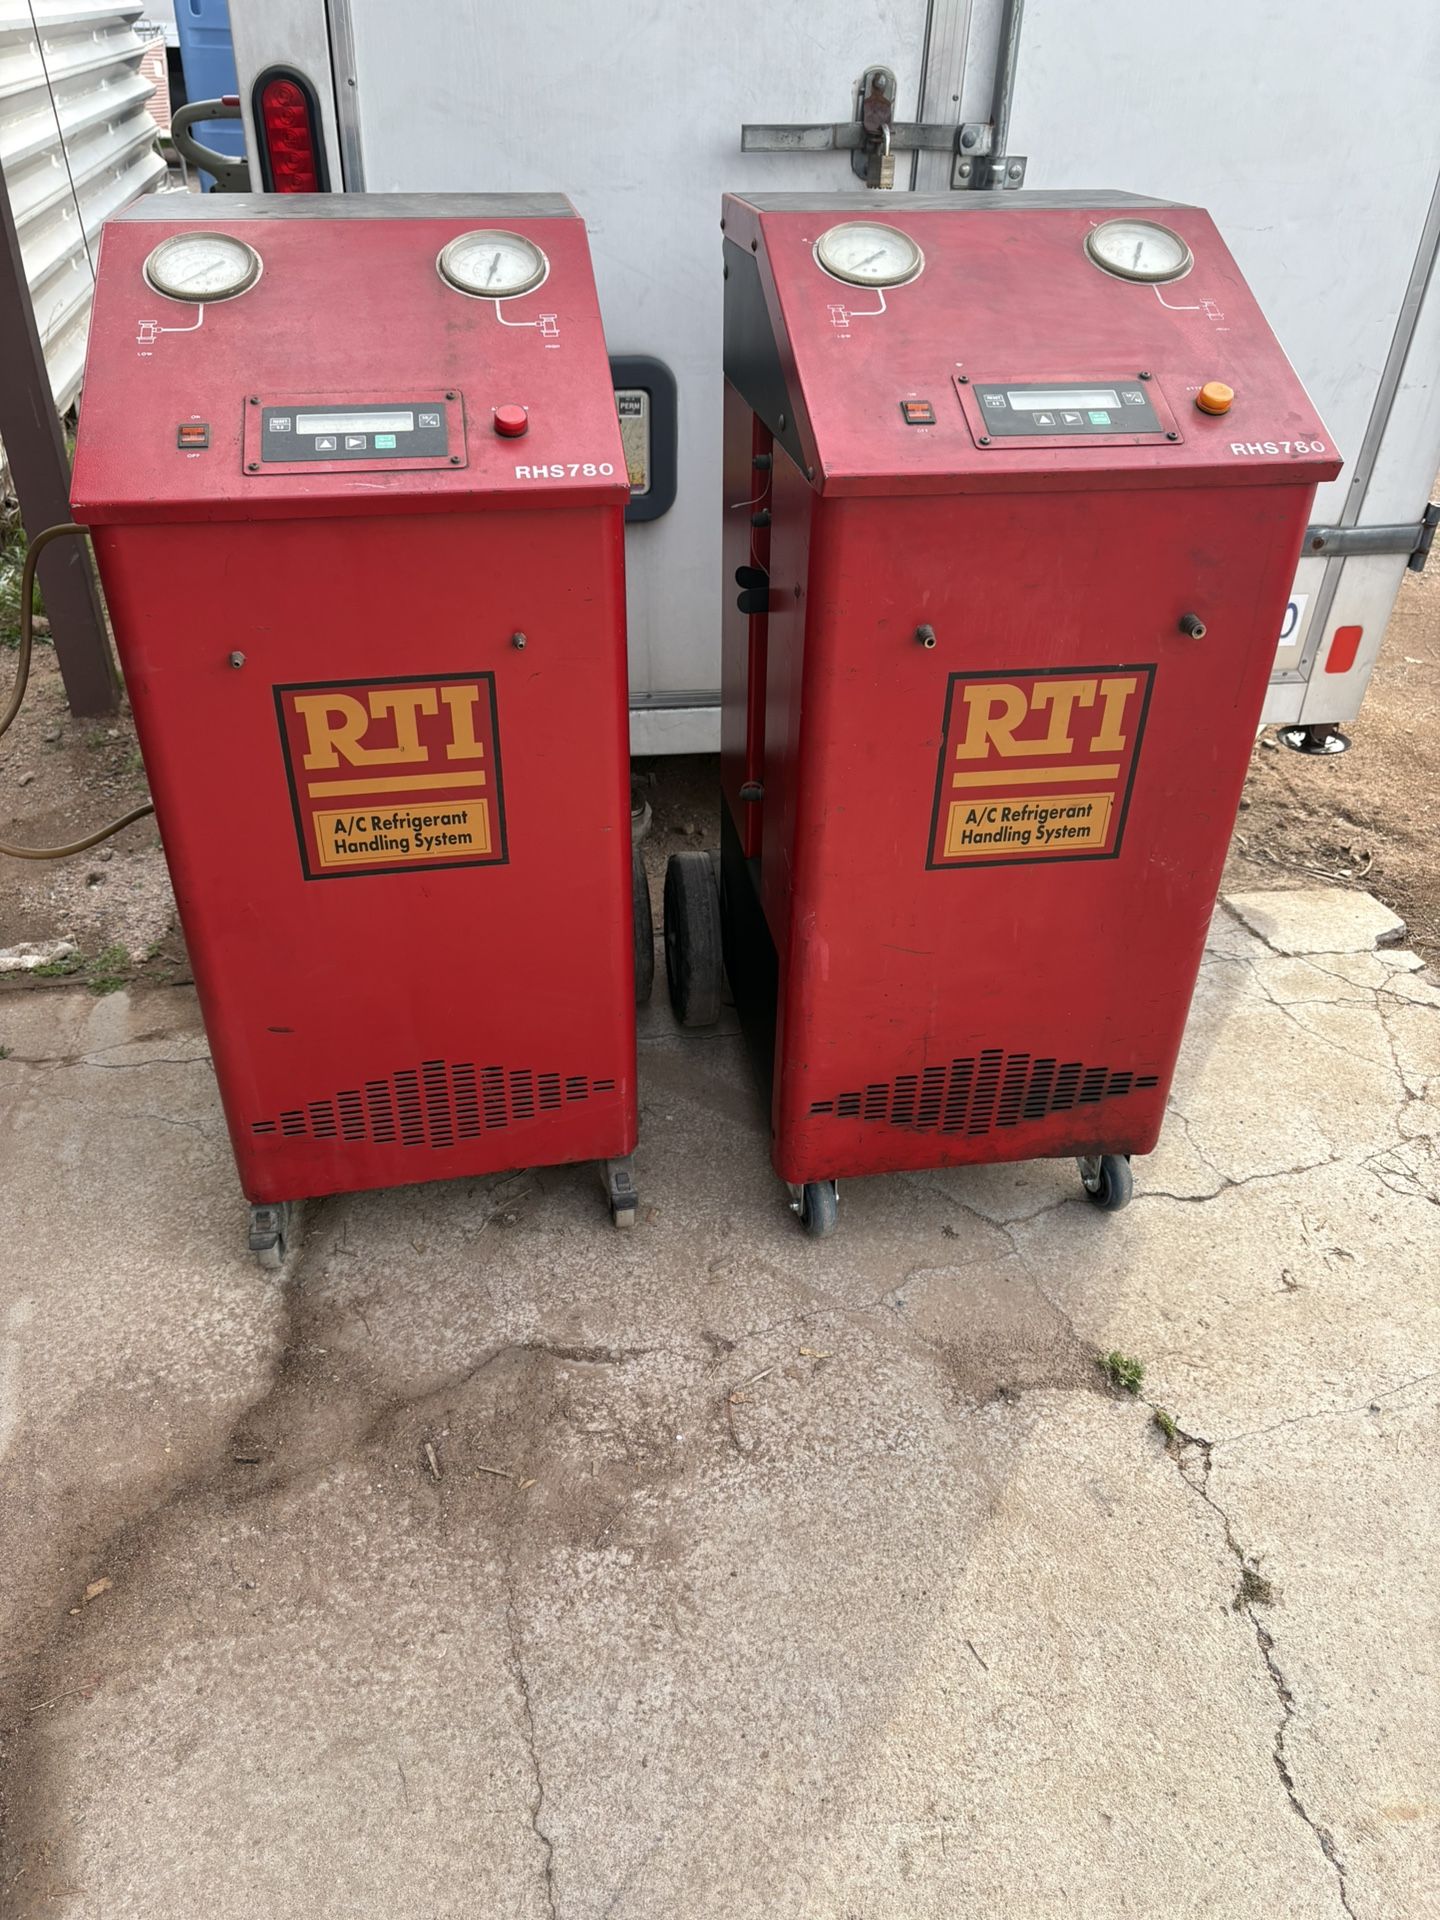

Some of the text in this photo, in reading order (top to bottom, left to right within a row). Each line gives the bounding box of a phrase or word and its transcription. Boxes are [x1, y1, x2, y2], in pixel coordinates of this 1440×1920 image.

[1230, 440, 1325, 456] RHS780
[514, 462, 614, 479] RHS780
[294, 685, 484, 770] RTI
[956, 678, 1137, 760] RTI
[334, 810, 469, 836] A/C Refrigerant
[965, 803, 1093, 826] A/C Refrigerant
[334, 832, 473, 855] Handling System
[961, 824, 1091, 845] Handling System
